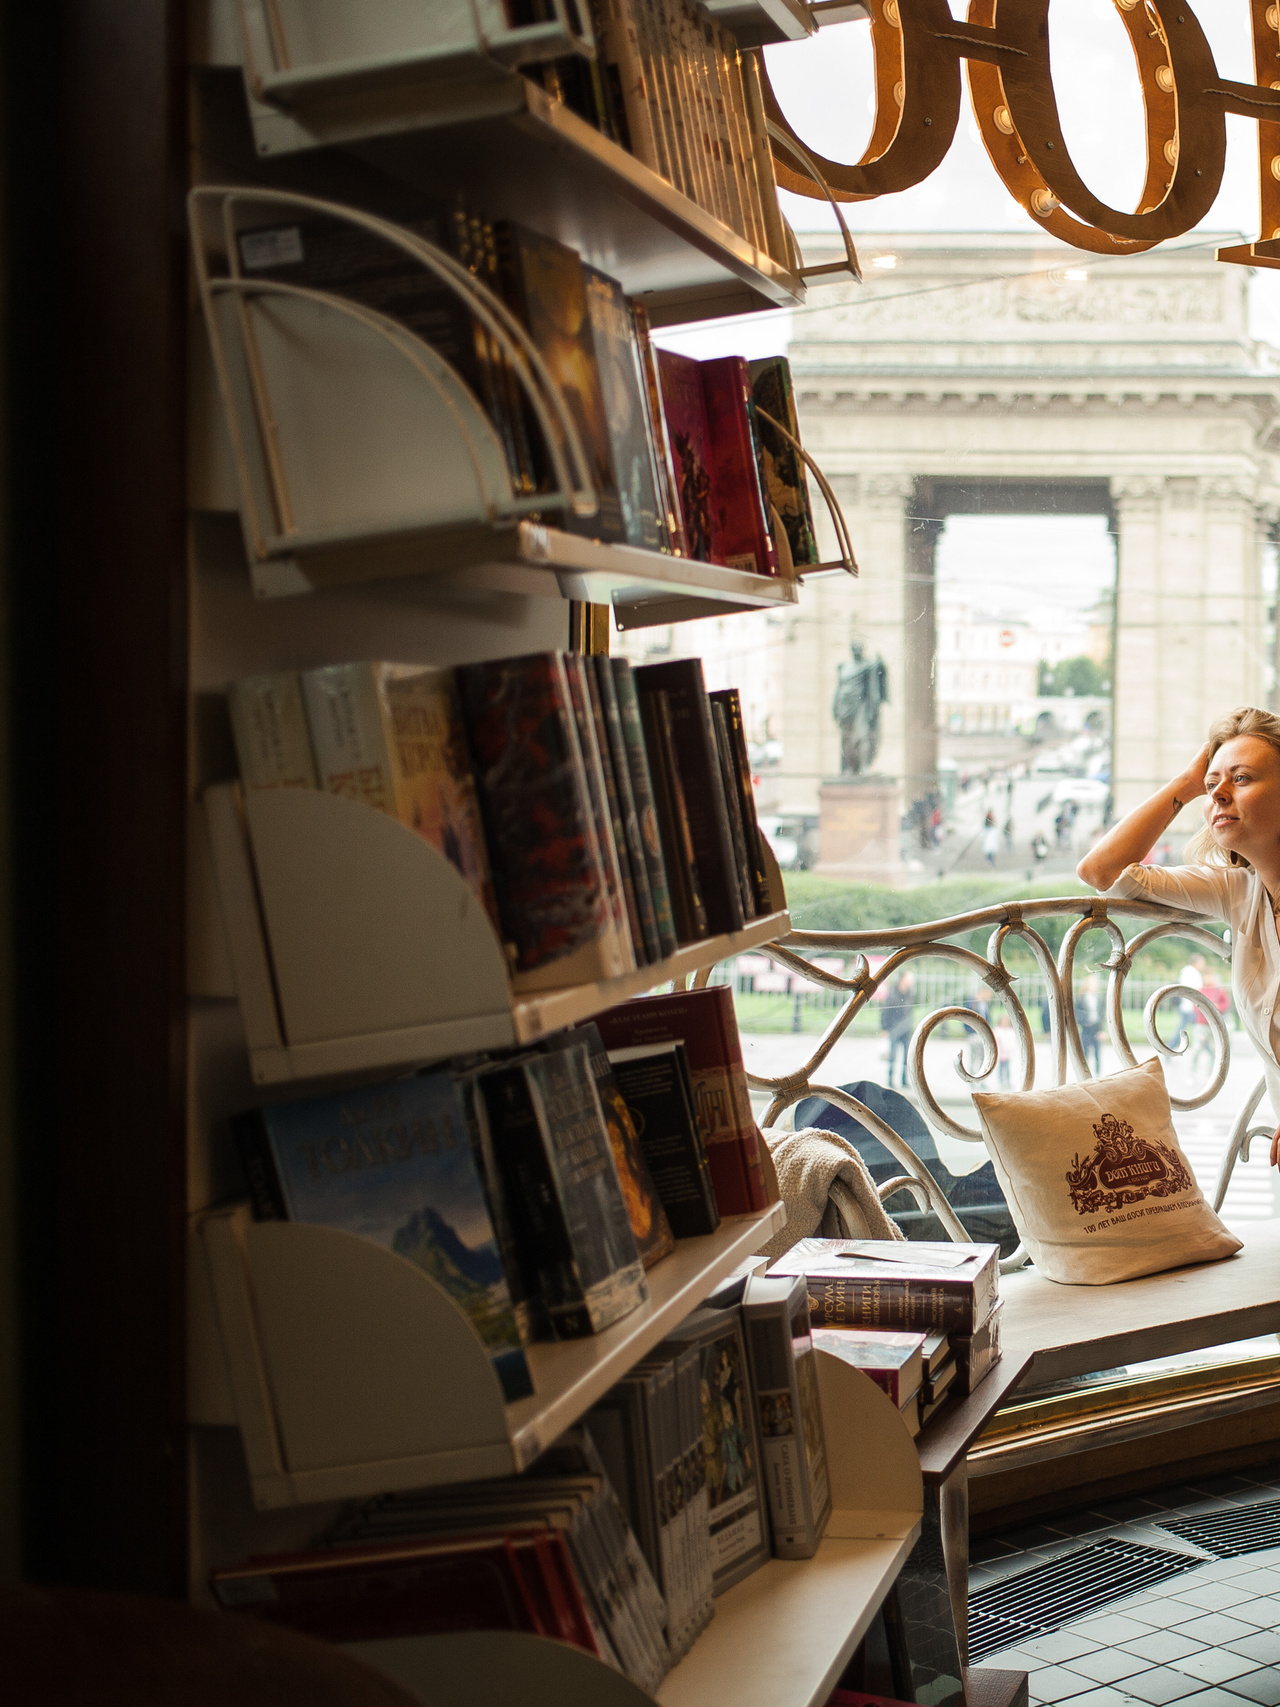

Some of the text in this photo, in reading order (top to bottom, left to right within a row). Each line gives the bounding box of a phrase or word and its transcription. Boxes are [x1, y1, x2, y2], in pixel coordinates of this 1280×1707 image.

[1084, 1226, 1097, 1234] 100
[1098, 1220, 1111, 1231] ЛЕТ
[1112, 1214, 1126, 1225] ВАШ
[1126, 1210, 1146, 1221] ДОСУГ
[1146, 1204, 1178, 1216] ПРЕВРАЩАЕМ
[824, 1284, 834, 1324] УРСУЛА
[780, 1444, 790, 1466] САГА
